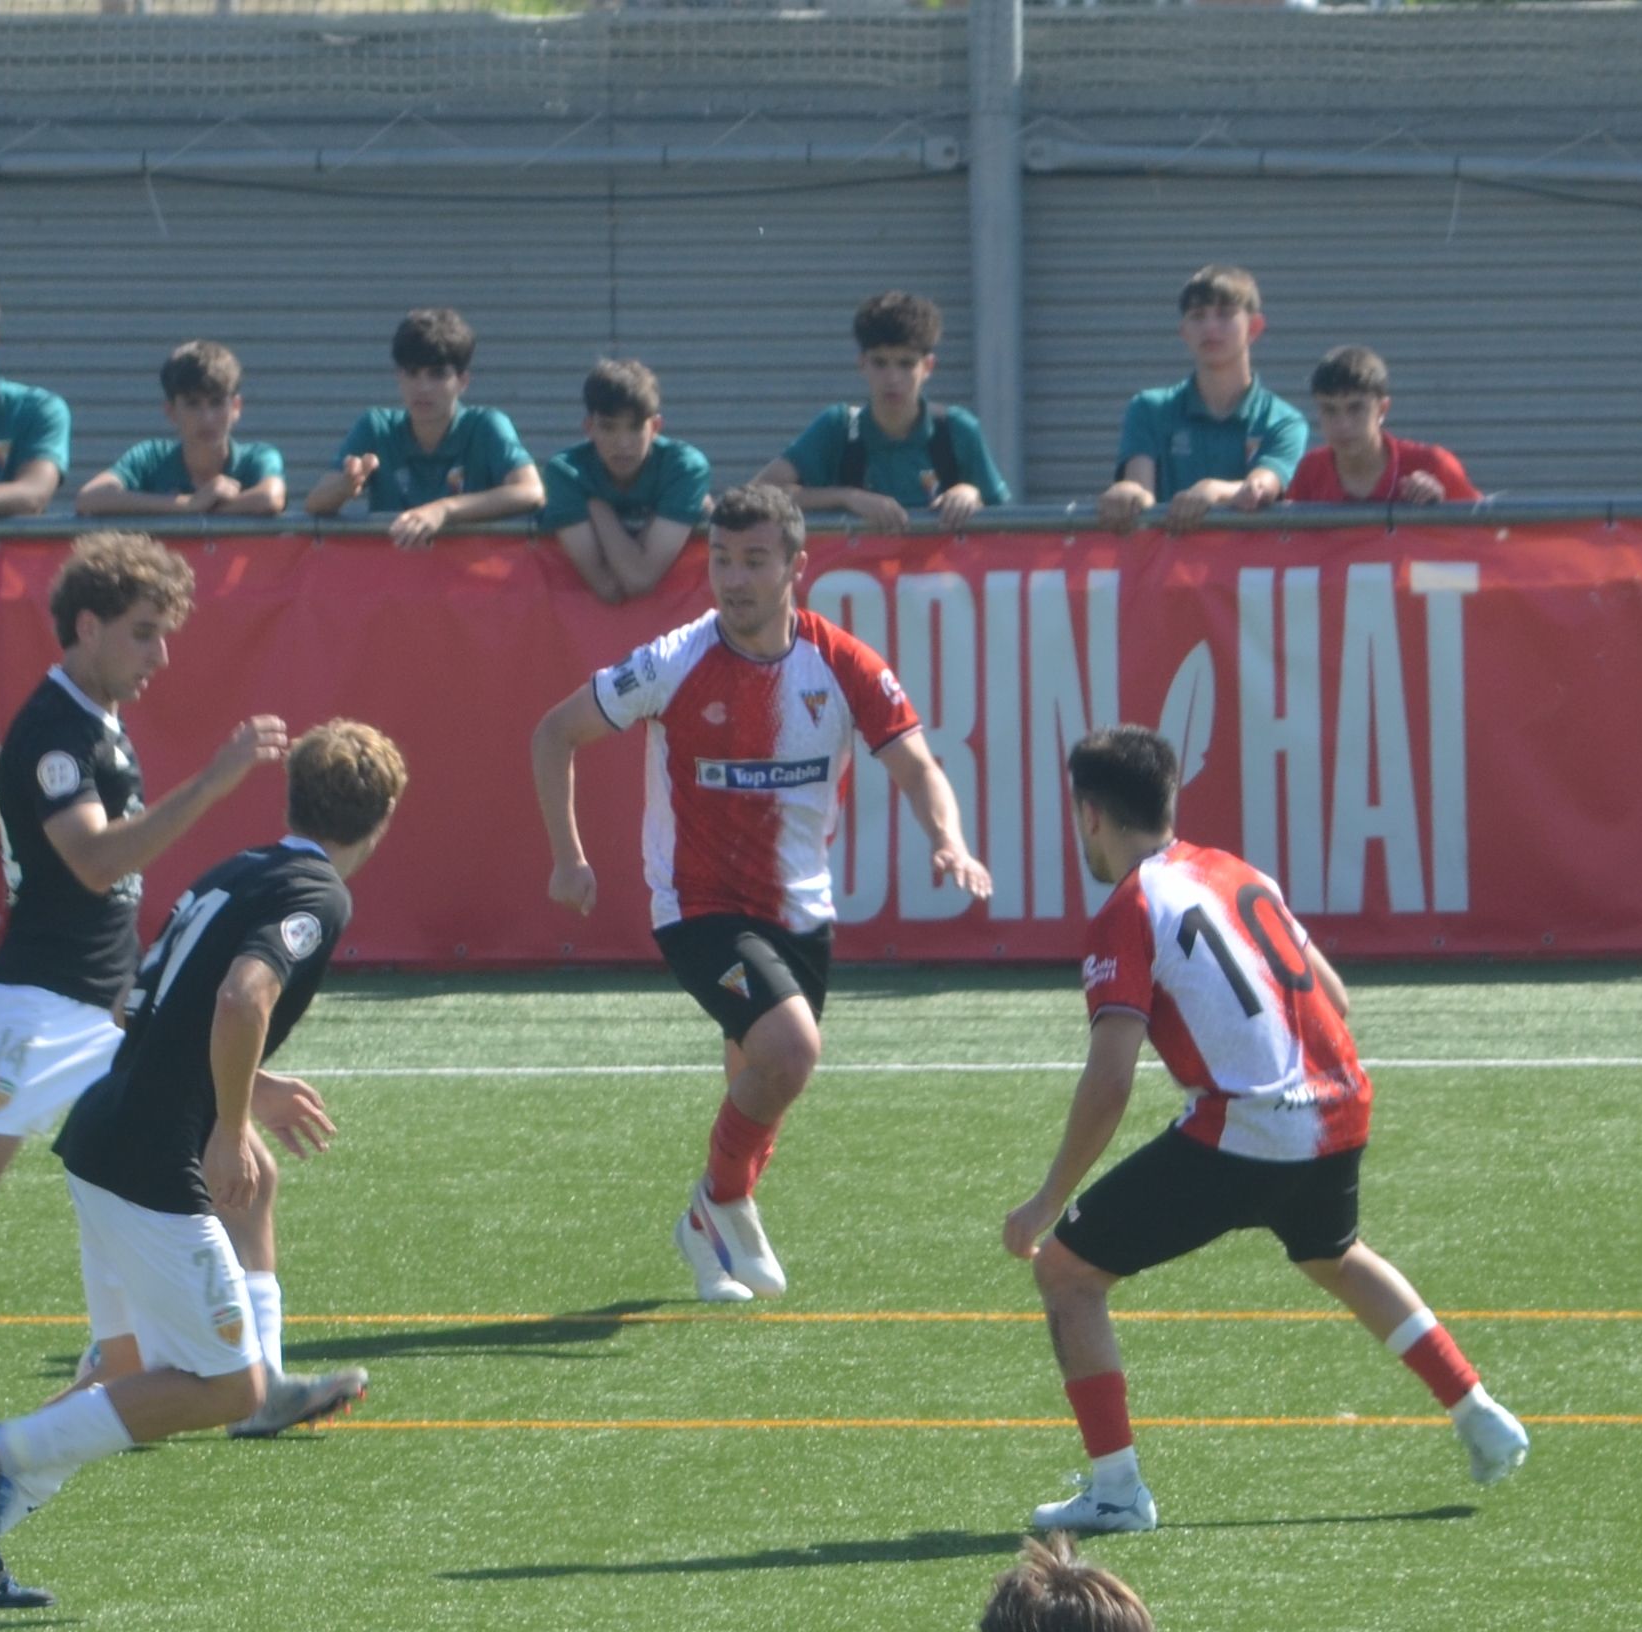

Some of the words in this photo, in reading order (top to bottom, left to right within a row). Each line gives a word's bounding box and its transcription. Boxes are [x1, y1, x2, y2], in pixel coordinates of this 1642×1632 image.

[731, 766, 767, 788] Top
[806, 568, 1121, 924] OBIN
[1238, 561, 1481, 915] HAT
[1176, 882, 1314, 1019] 10
